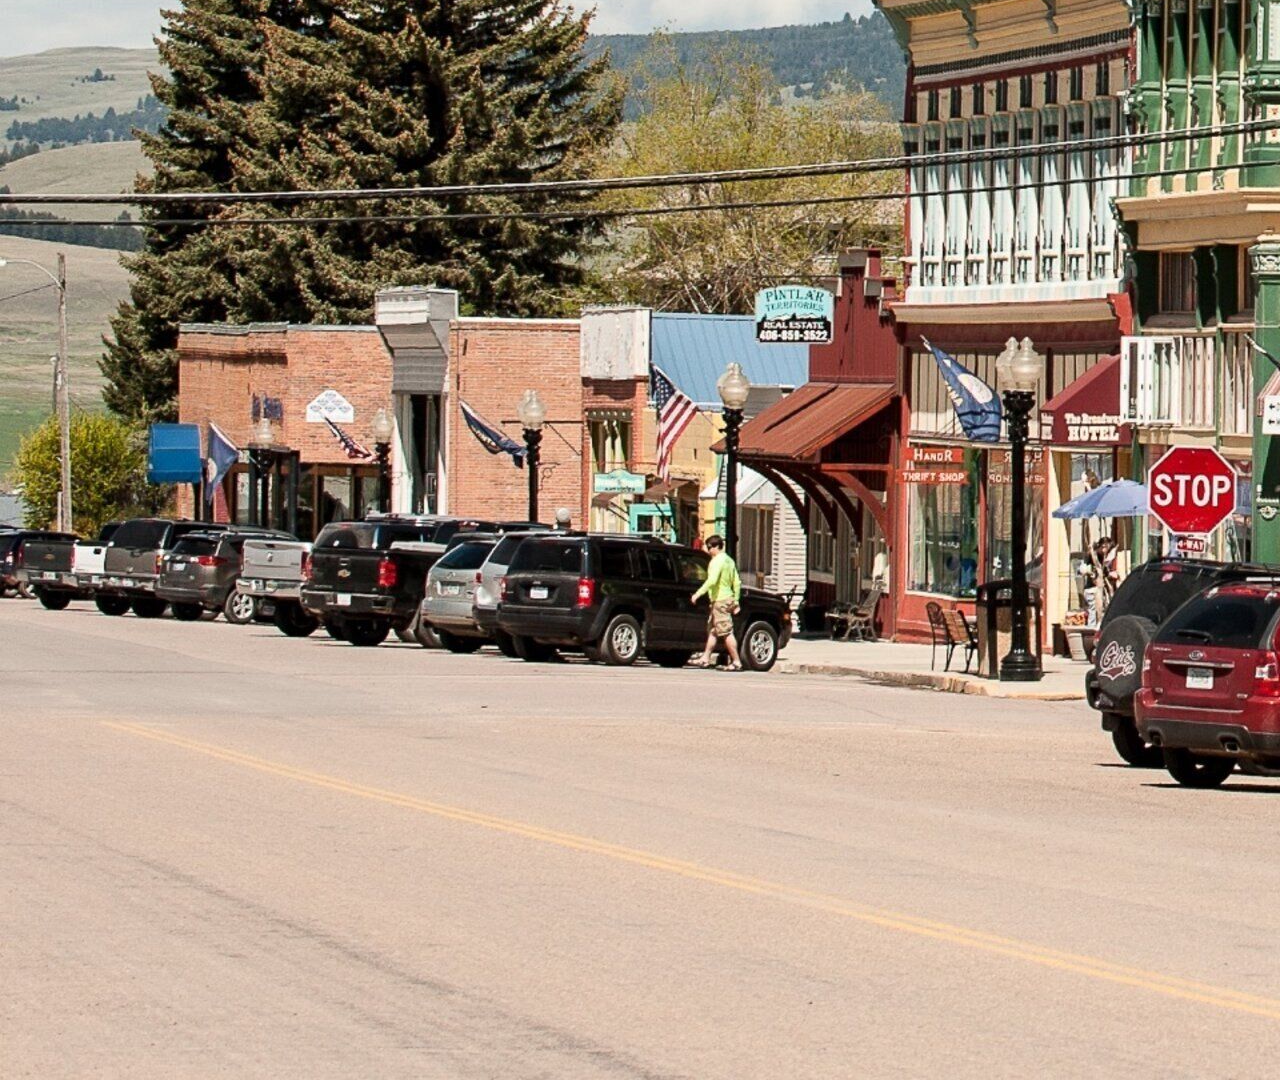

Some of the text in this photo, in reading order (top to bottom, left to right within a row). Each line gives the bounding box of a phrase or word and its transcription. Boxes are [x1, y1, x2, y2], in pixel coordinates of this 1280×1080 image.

[765, 288, 825, 302] PINTLAR
[765, 301, 824, 312] TERRITORIES
[763, 321, 825, 329] REAL ESTATE
[1067, 425, 1120, 442] HOTEL
[902, 472, 965, 481] THRIFT SHOP
[1153, 473, 1232, 507] STOP
